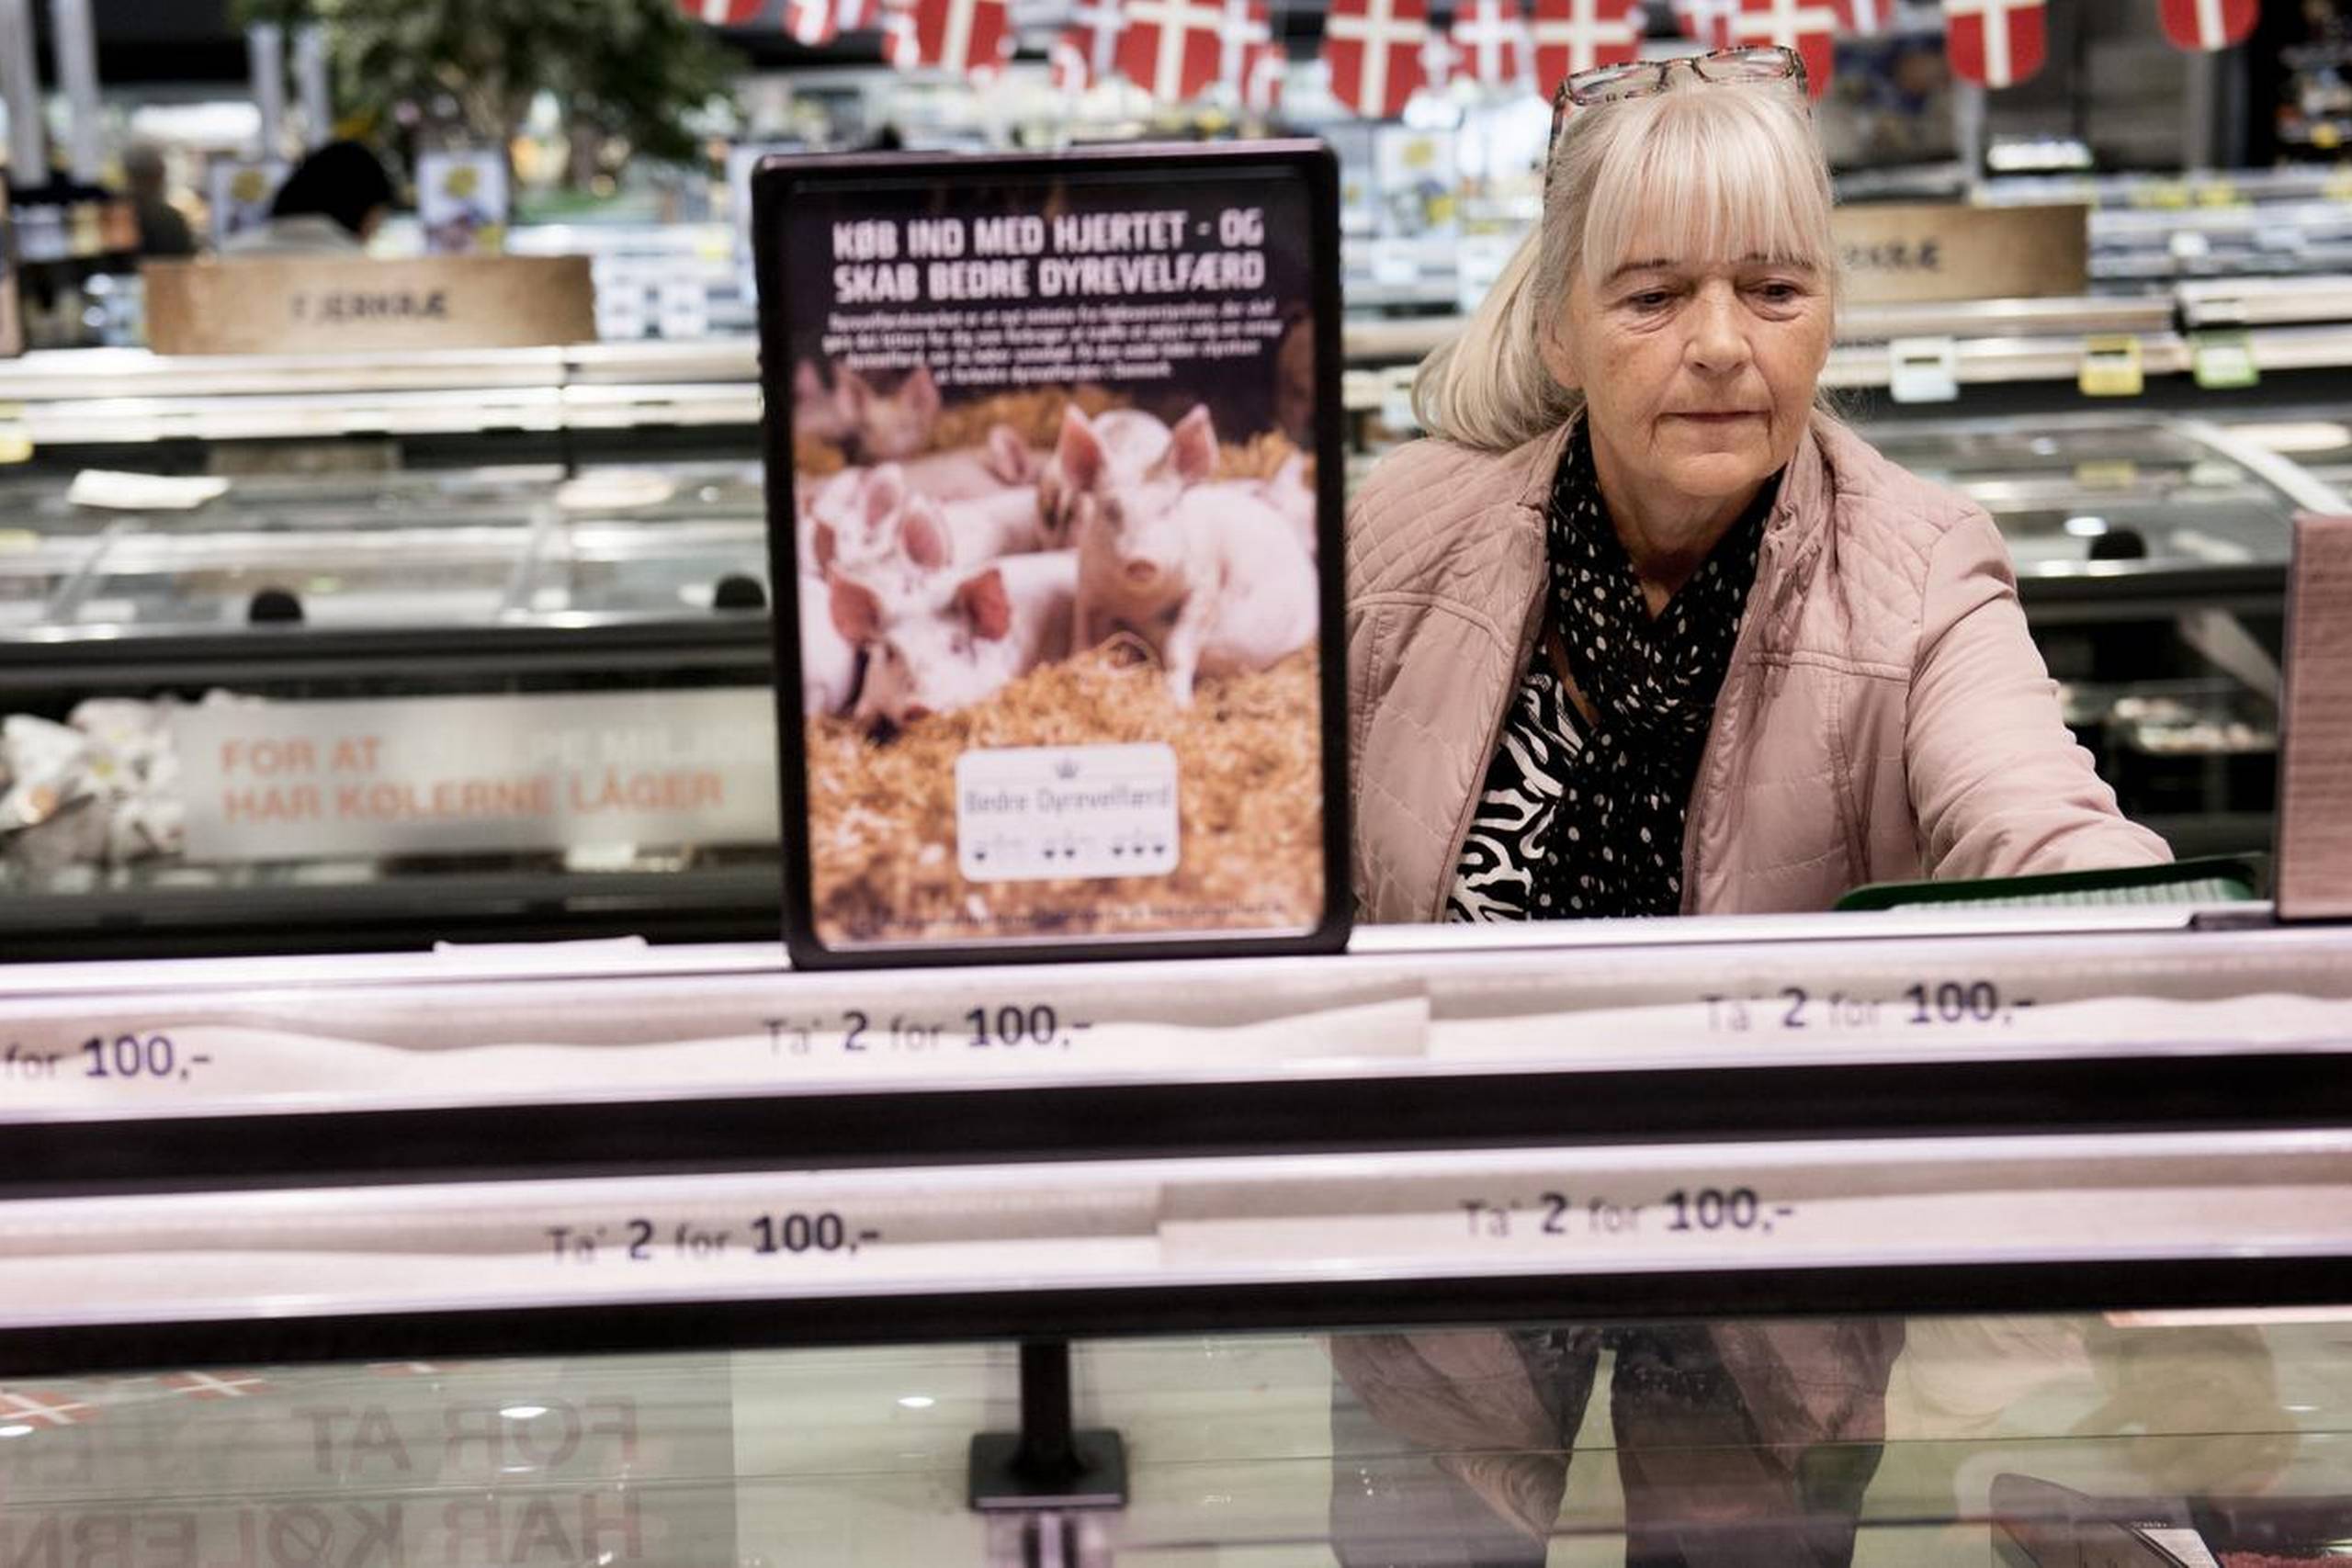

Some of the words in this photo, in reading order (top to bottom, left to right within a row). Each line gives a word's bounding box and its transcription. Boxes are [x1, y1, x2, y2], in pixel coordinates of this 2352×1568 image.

[832, 220, 899, 261] KØB
[908, 218, 965, 258] IND
[974, 215, 1045, 256] MED
[1054, 209, 1188, 254] HJERTET
[1219, 207, 1265, 247] OG
[833, 263, 919, 304] SKAB
[928, 258, 1031, 301] BEDRE
[1038, 250, 1265, 297] DYREVELFÆRD
[220, 736, 316, 773] FOR
[331, 733, 382, 773] AT
[220, 783, 324, 823] HAR
[841, 1010, 869, 1051] 2
[888, 1013, 945, 1051] for
[964, 1003, 1093, 1047] 100,-
[1780, 986, 1807, 1027] 2
[1904, 980, 2035, 1026] 100,-
[82, 1033, 211, 1082] 100,-
[1540, 1191, 1567, 1234] 2
[1588, 1196, 1642, 1233] for
[1663, 1187, 1794, 1234] 100,-
[627, 1218, 654, 1260] 2
[674, 1221, 731, 1255] for
[751, 1211, 882, 1259] 100,-
